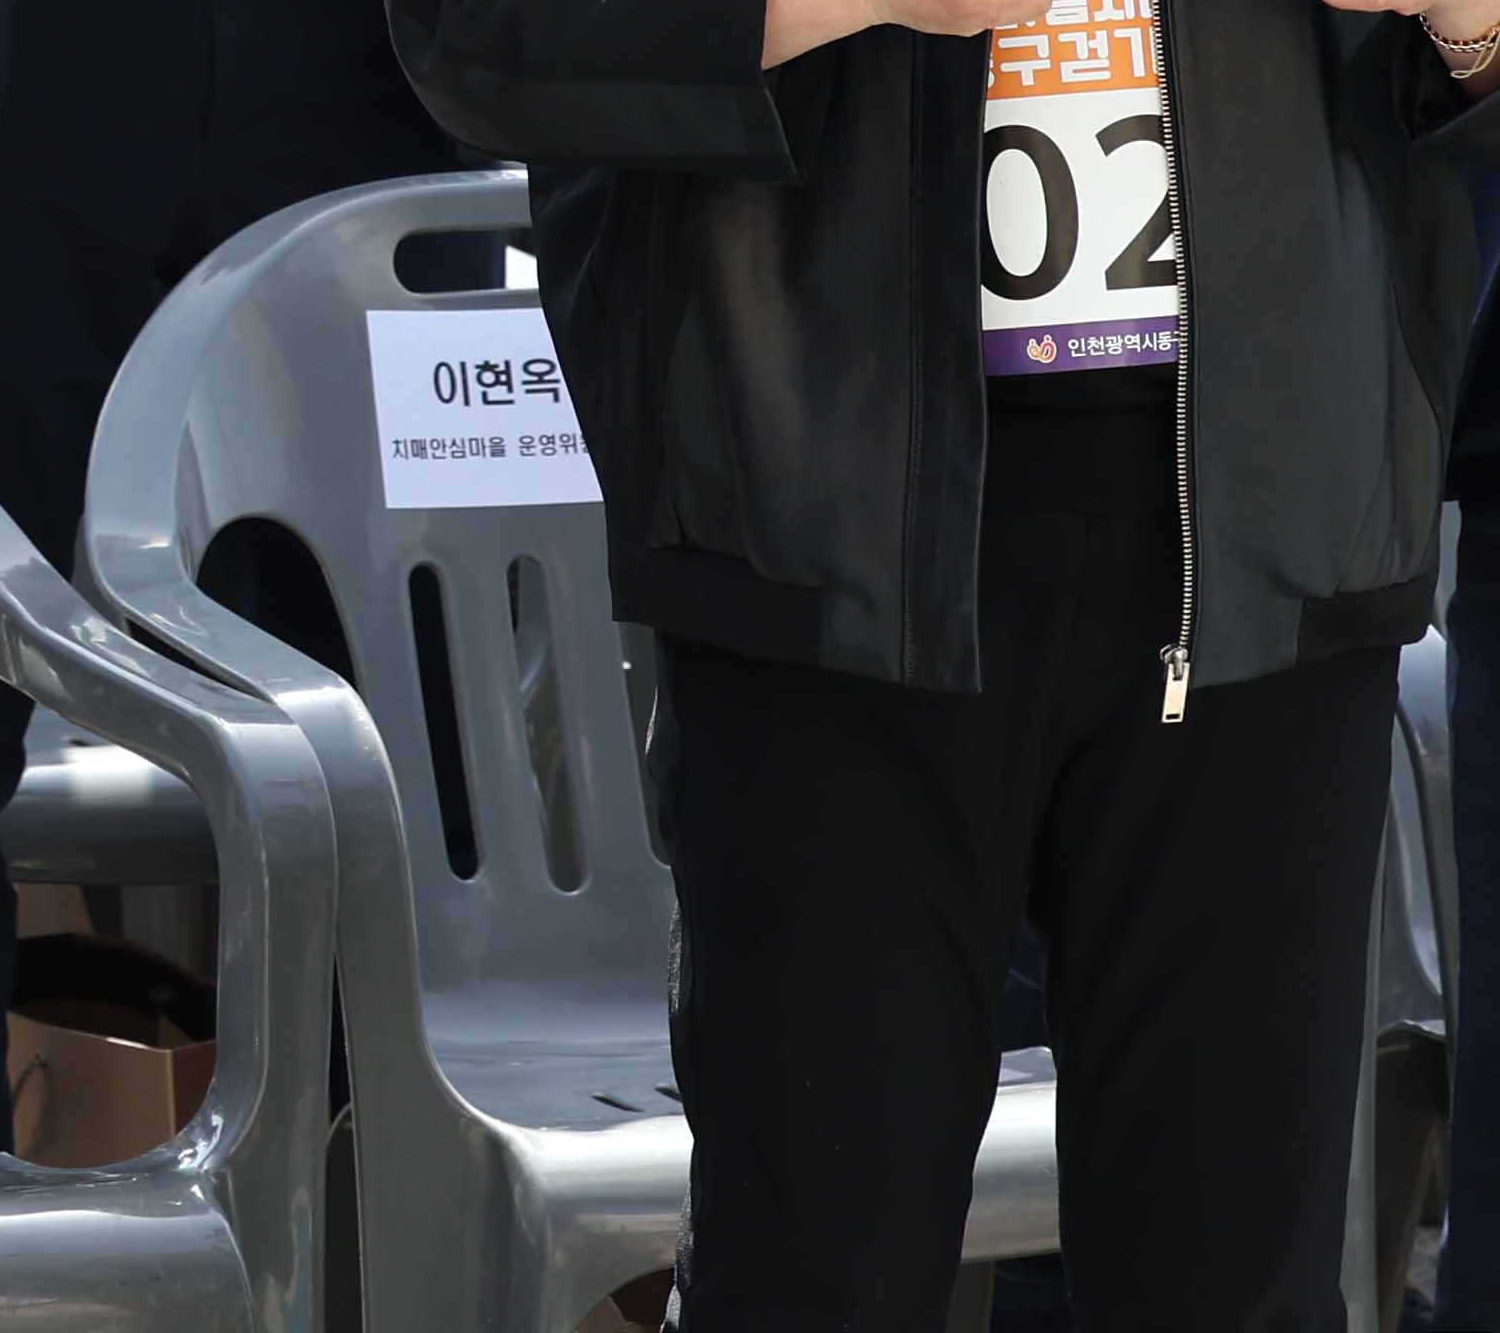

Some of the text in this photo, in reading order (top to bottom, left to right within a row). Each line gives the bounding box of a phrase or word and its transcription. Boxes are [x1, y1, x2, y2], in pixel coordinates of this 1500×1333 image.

[988, 27, 1161, 88] 구걷기
[433, 358, 561, 407] 이현옥
[392, 436, 506, 460] 치매안심마을
